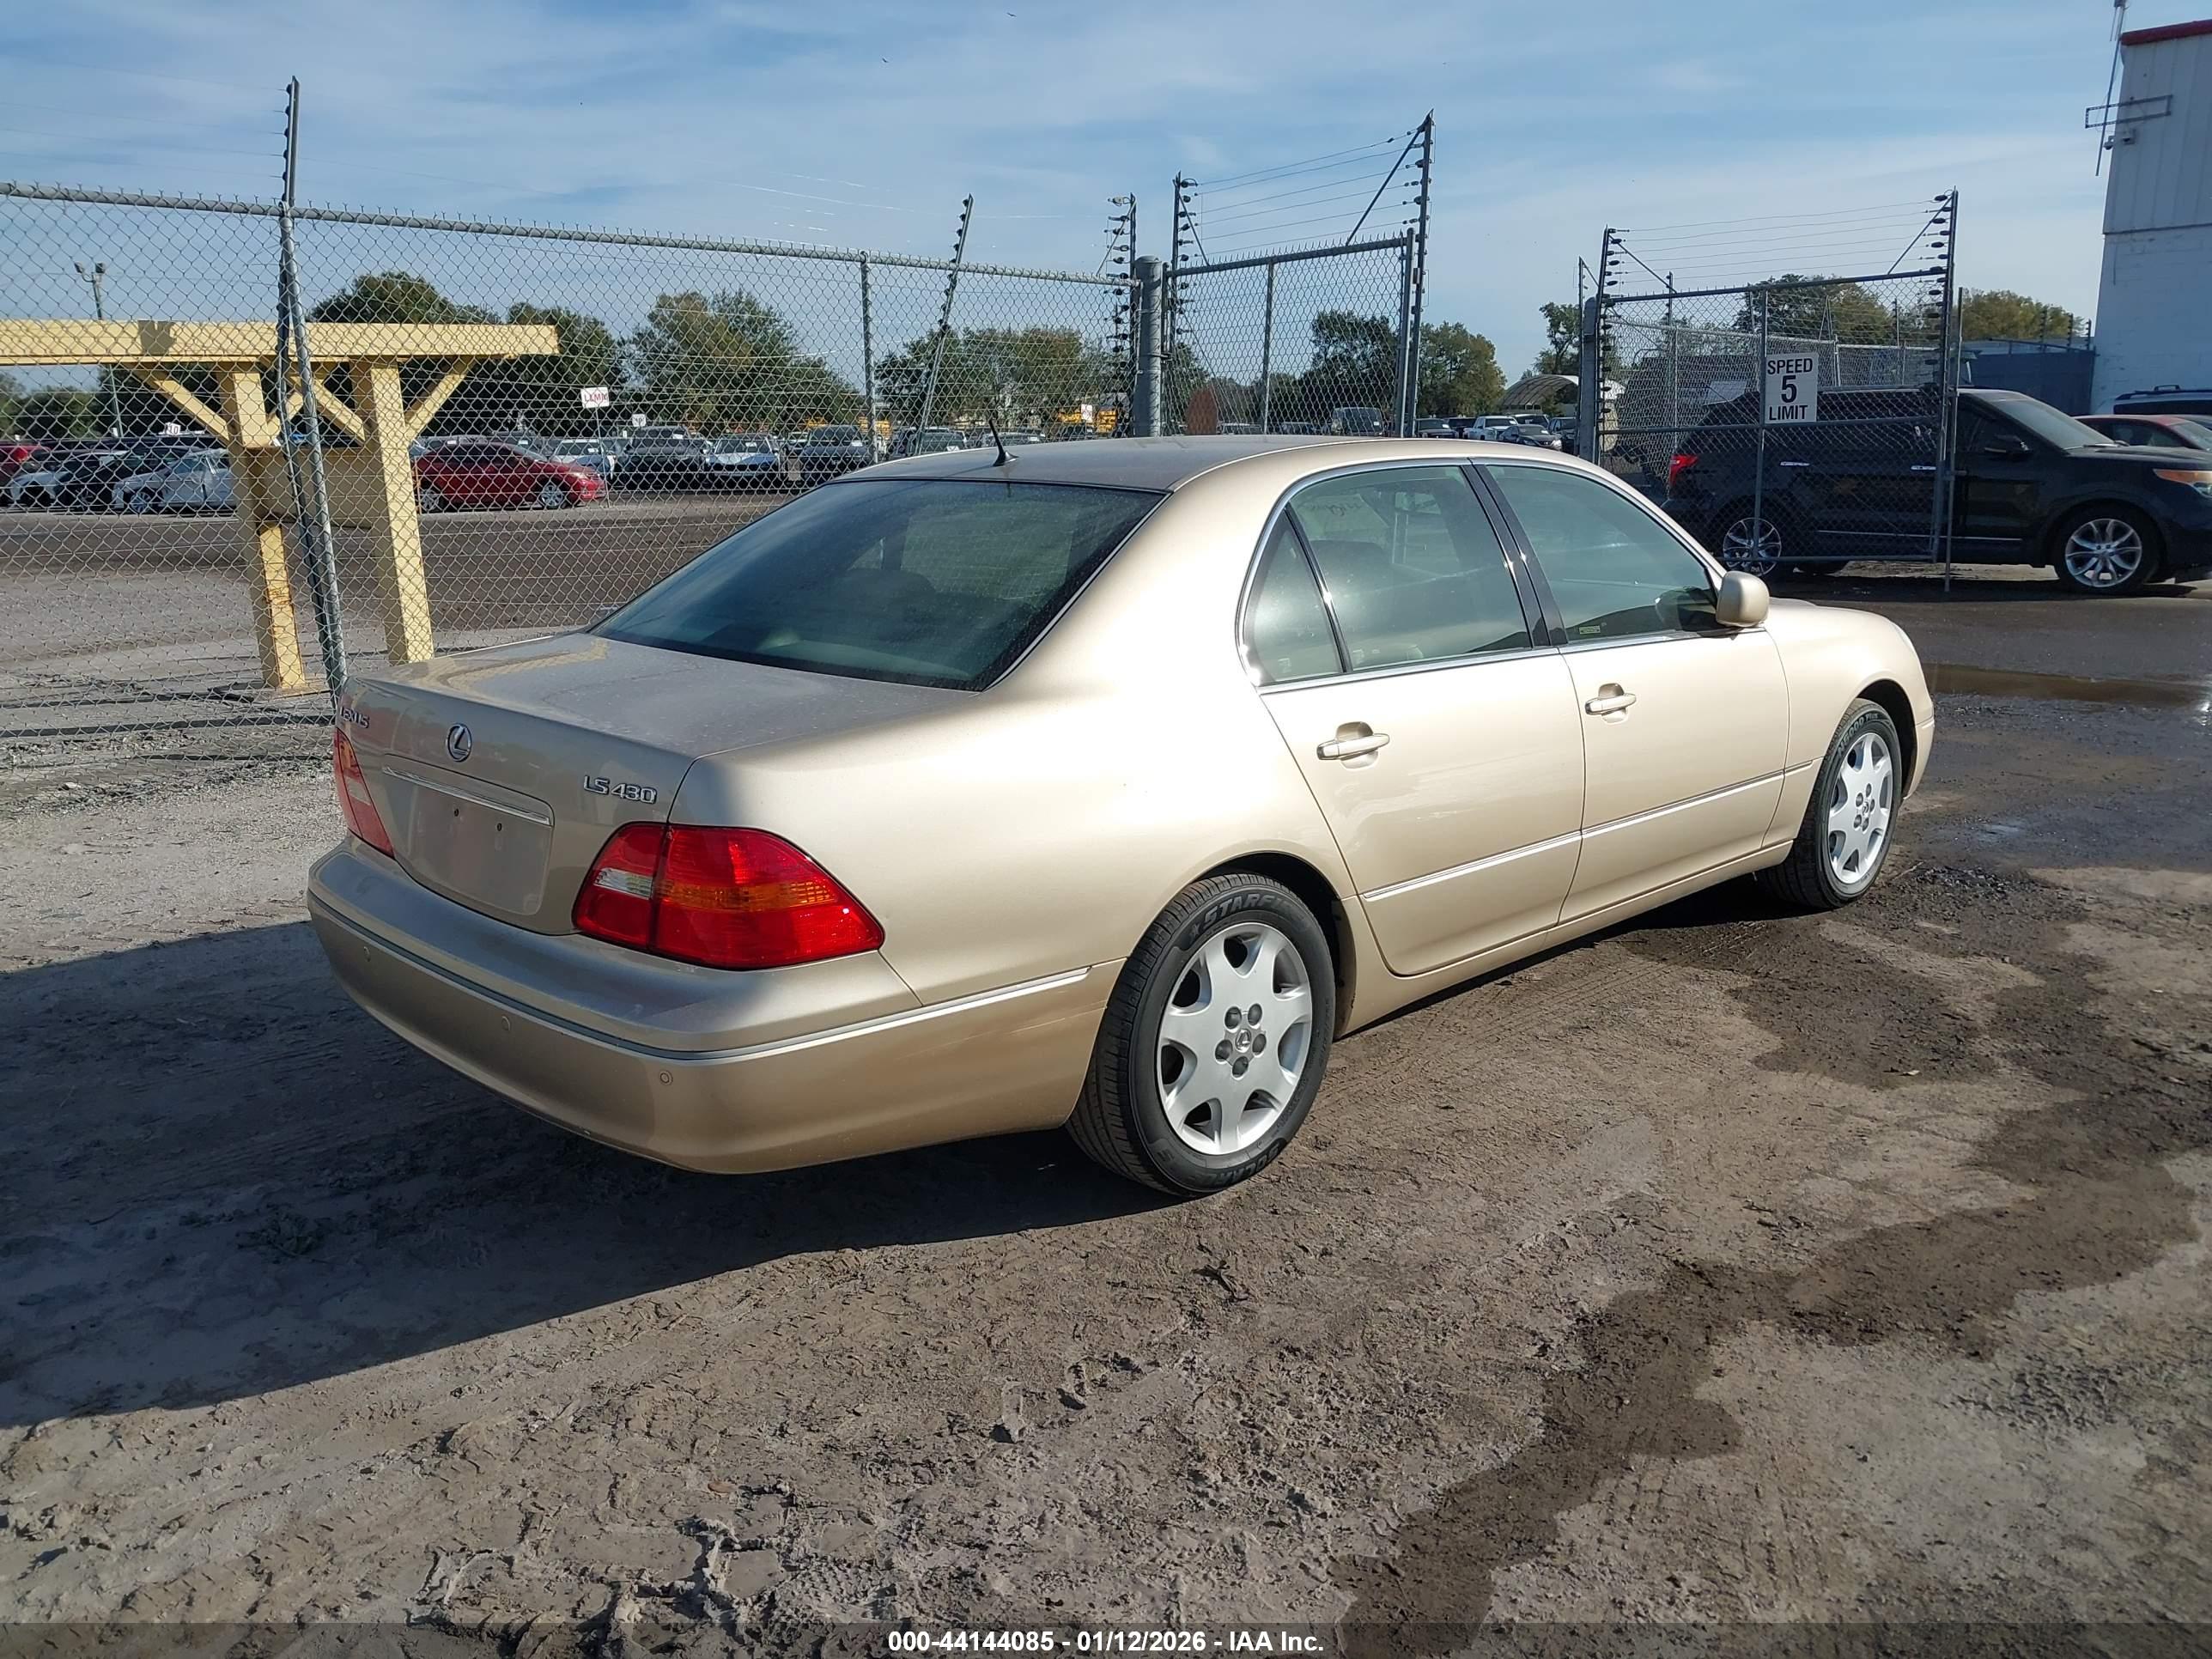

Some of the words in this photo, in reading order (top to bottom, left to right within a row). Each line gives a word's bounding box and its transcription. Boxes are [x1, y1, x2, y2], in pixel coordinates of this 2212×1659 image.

[1767, 358, 1813, 374] SPEED
[1781, 374, 1797, 403] 5
[1769, 405, 1808, 420] LIMIT
[583, 775, 610, 796] LS
[611, 782, 657, 805] 430
